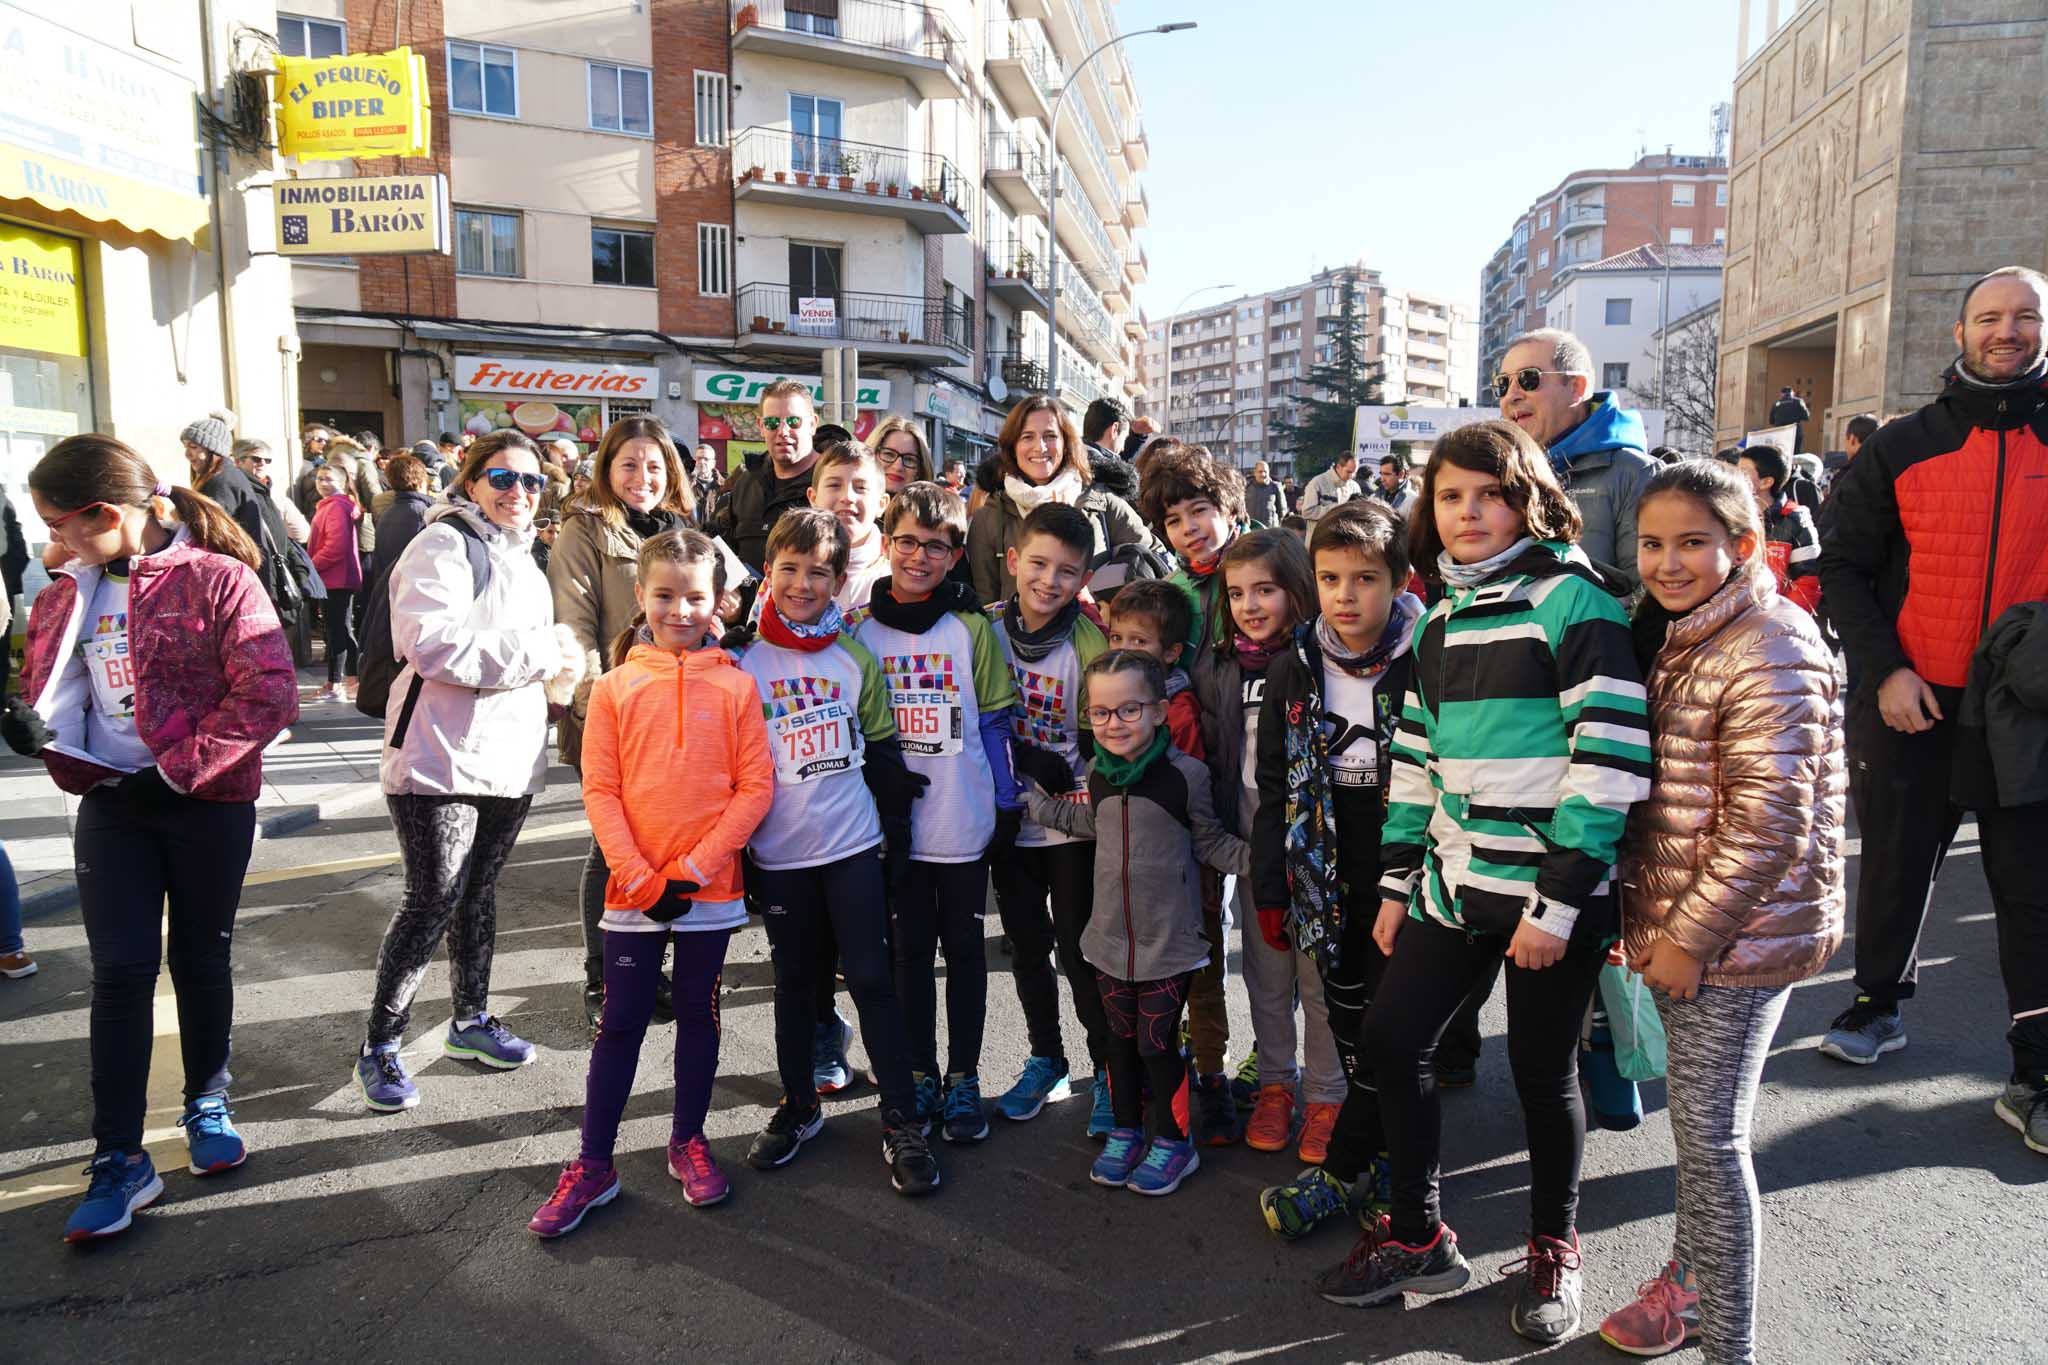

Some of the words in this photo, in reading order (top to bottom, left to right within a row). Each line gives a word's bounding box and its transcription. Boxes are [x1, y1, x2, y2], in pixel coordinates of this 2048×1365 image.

[289, 83, 312, 103] EL
[314, 66, 401, 95] PEQUEÑO
[312, 98, 384, 119] BIPER
[280, 183, 425, 204] INMOBILIARIA
[330, 207, 426, 233] BARÓN
[469, 362, 648, 394] Fruterías
[893, 693, 953, 704] SETEL
[790, 705, 847, 728] SETEL
[891, 707, 939, 734] 065
[782, 721, 840, 761] 7377
[806, 760, 846, 773] ALJOMAR
